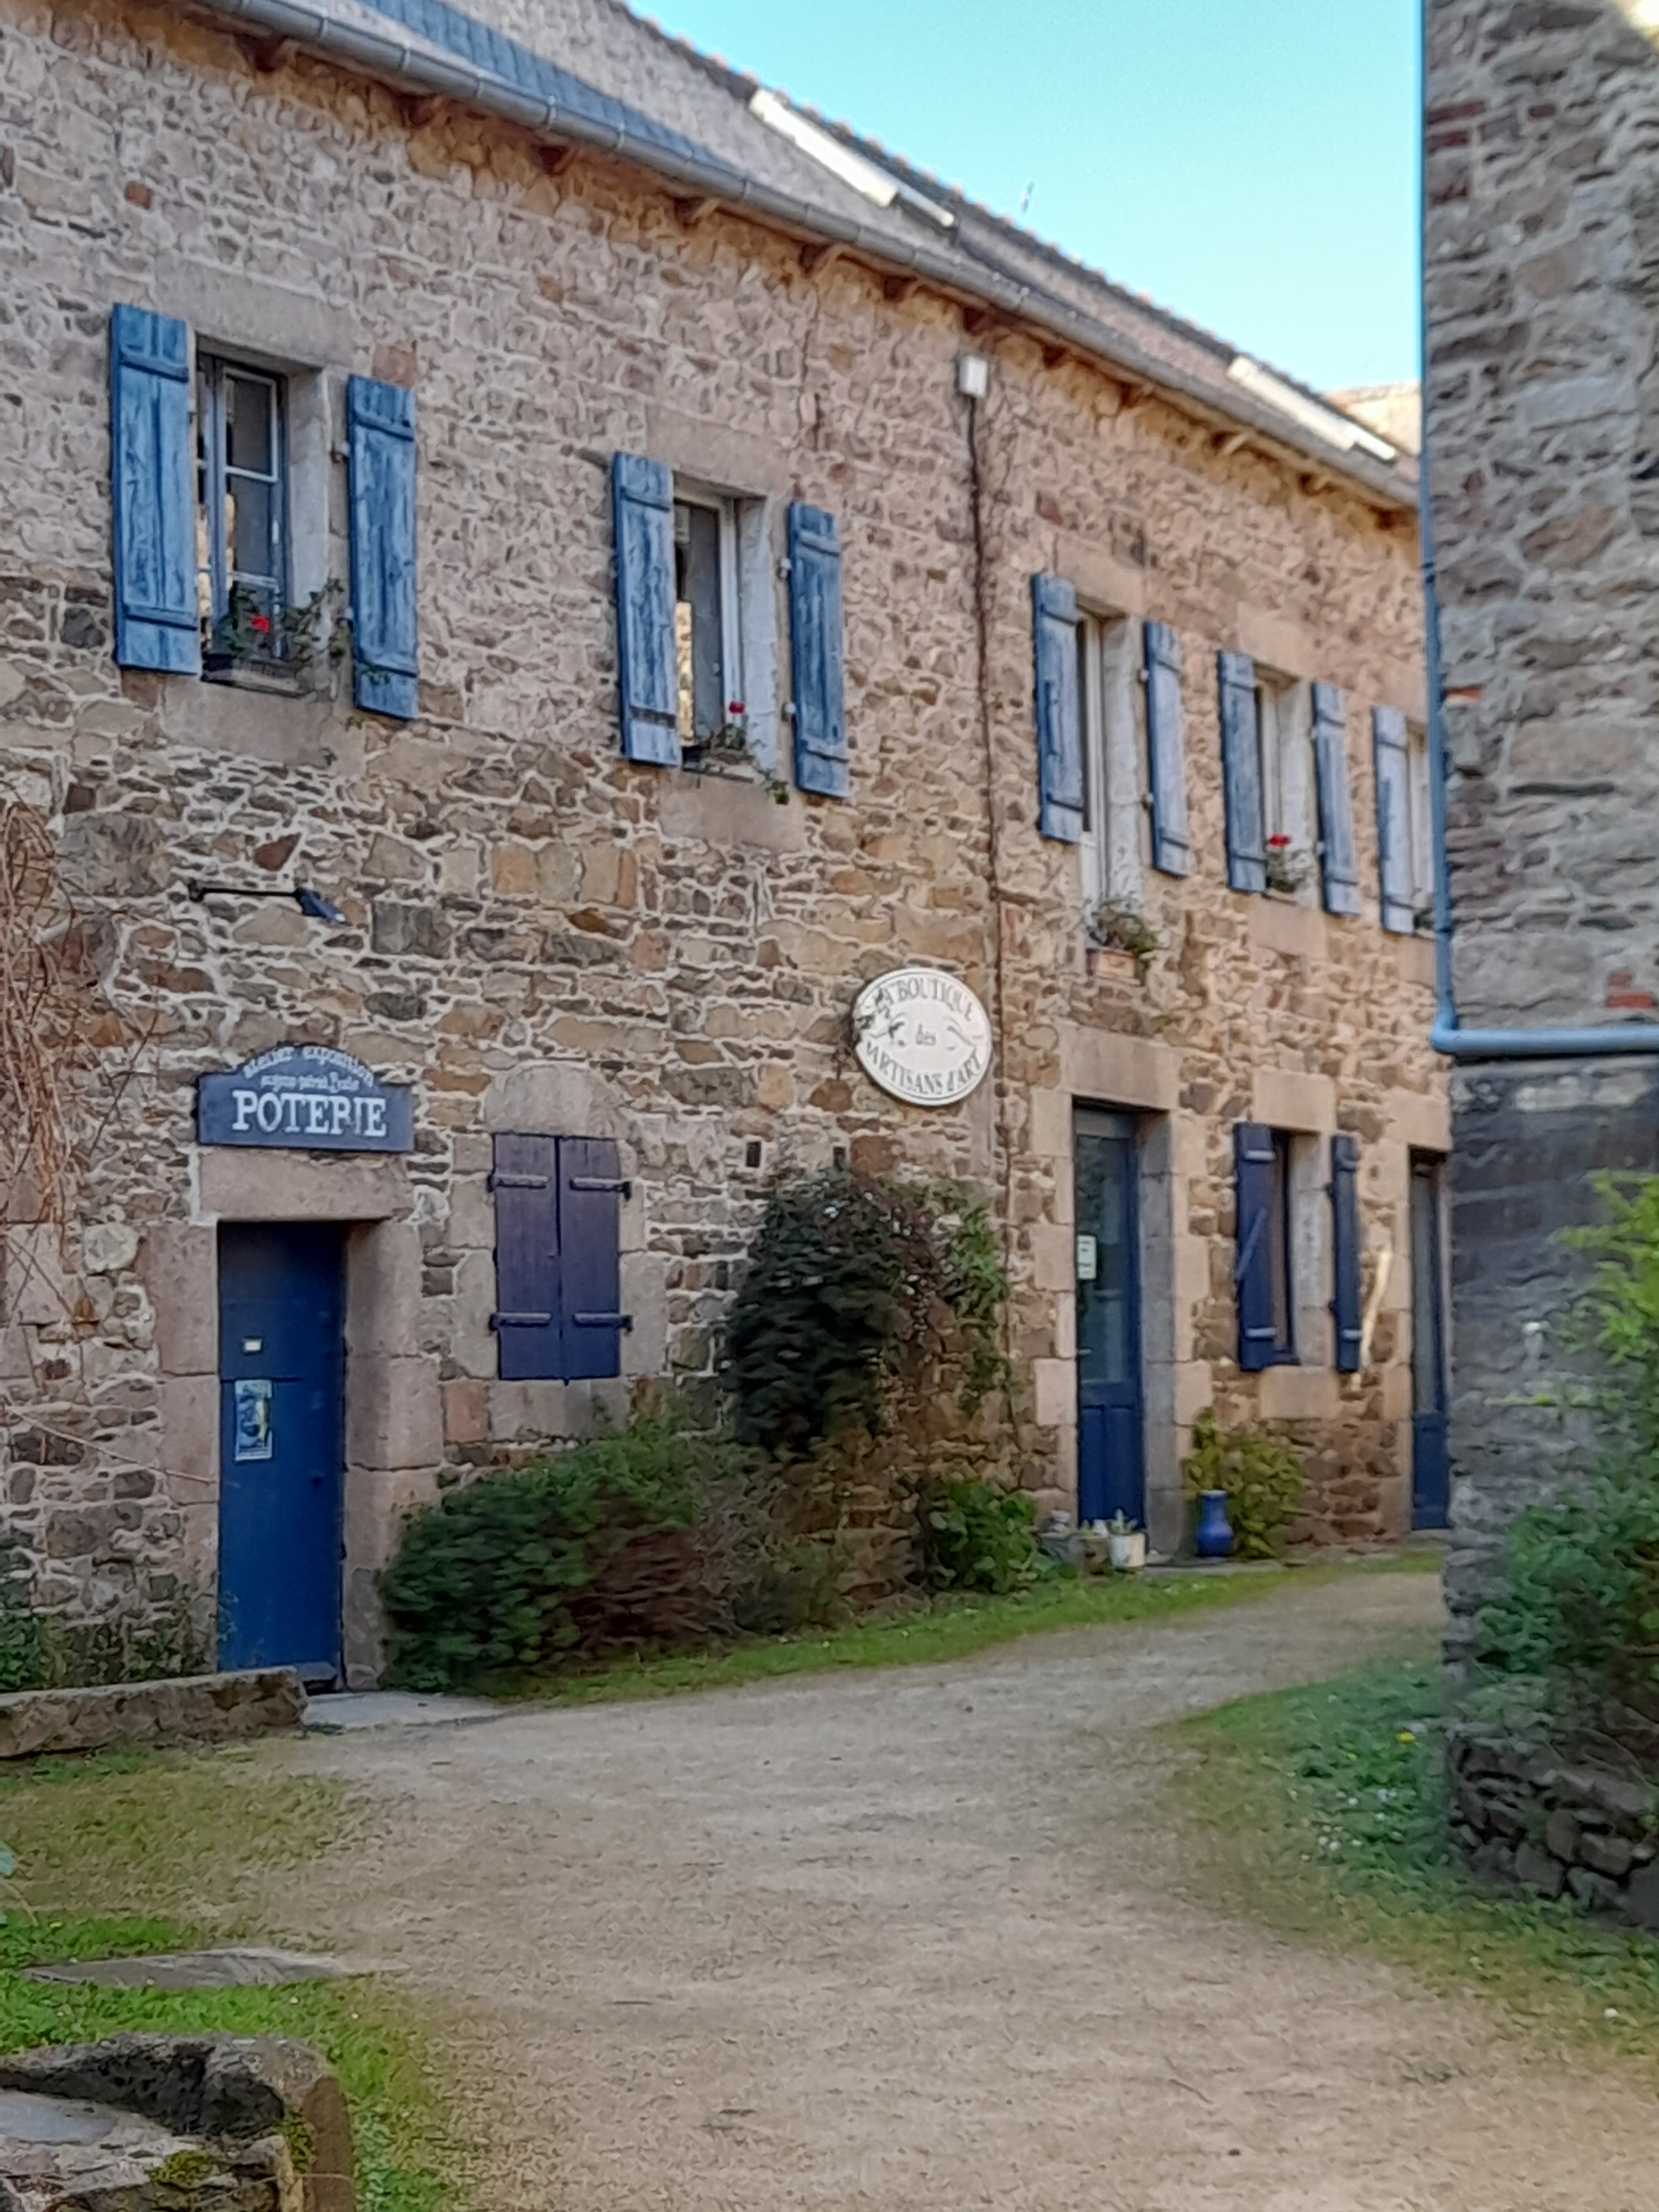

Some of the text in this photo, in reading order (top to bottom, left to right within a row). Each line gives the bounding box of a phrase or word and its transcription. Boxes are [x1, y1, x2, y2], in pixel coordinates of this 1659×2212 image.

[897, 977, 972, 1022] BOUTIQUE
[867, 1040, 942, 1094] ARTISANS
[231, 1089, 387, 1137] POTERIE
